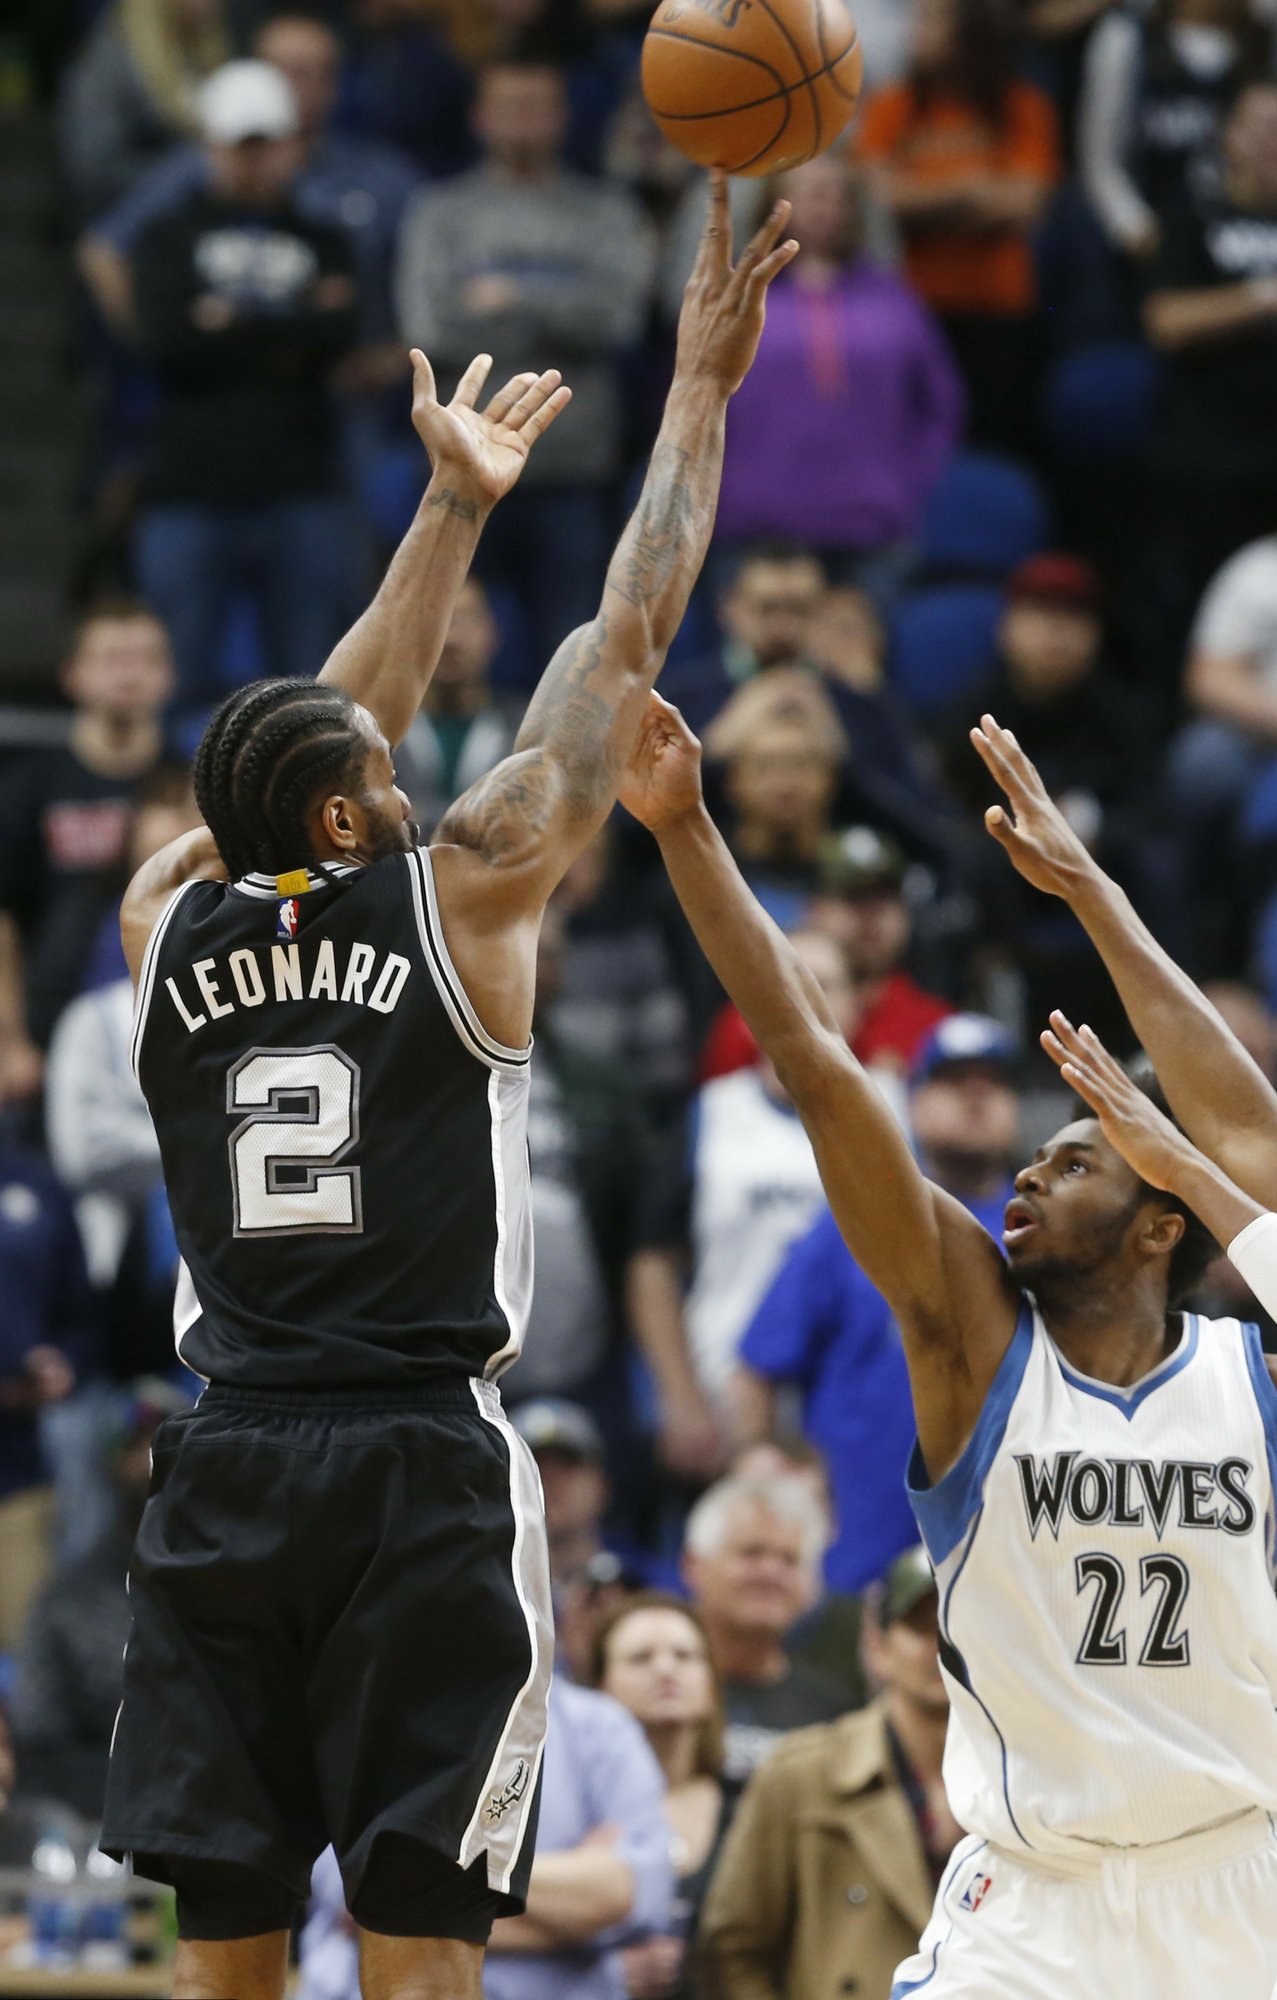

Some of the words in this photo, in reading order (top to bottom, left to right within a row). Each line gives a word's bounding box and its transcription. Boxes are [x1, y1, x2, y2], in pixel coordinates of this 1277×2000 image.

[165, 939, 412, 1033] LEONARD
[226, 1043, 363, 1238] 2
[1013, 1450, 1257, 1542] WOLVES
[1074, 1552, 1191, 1667] 22
